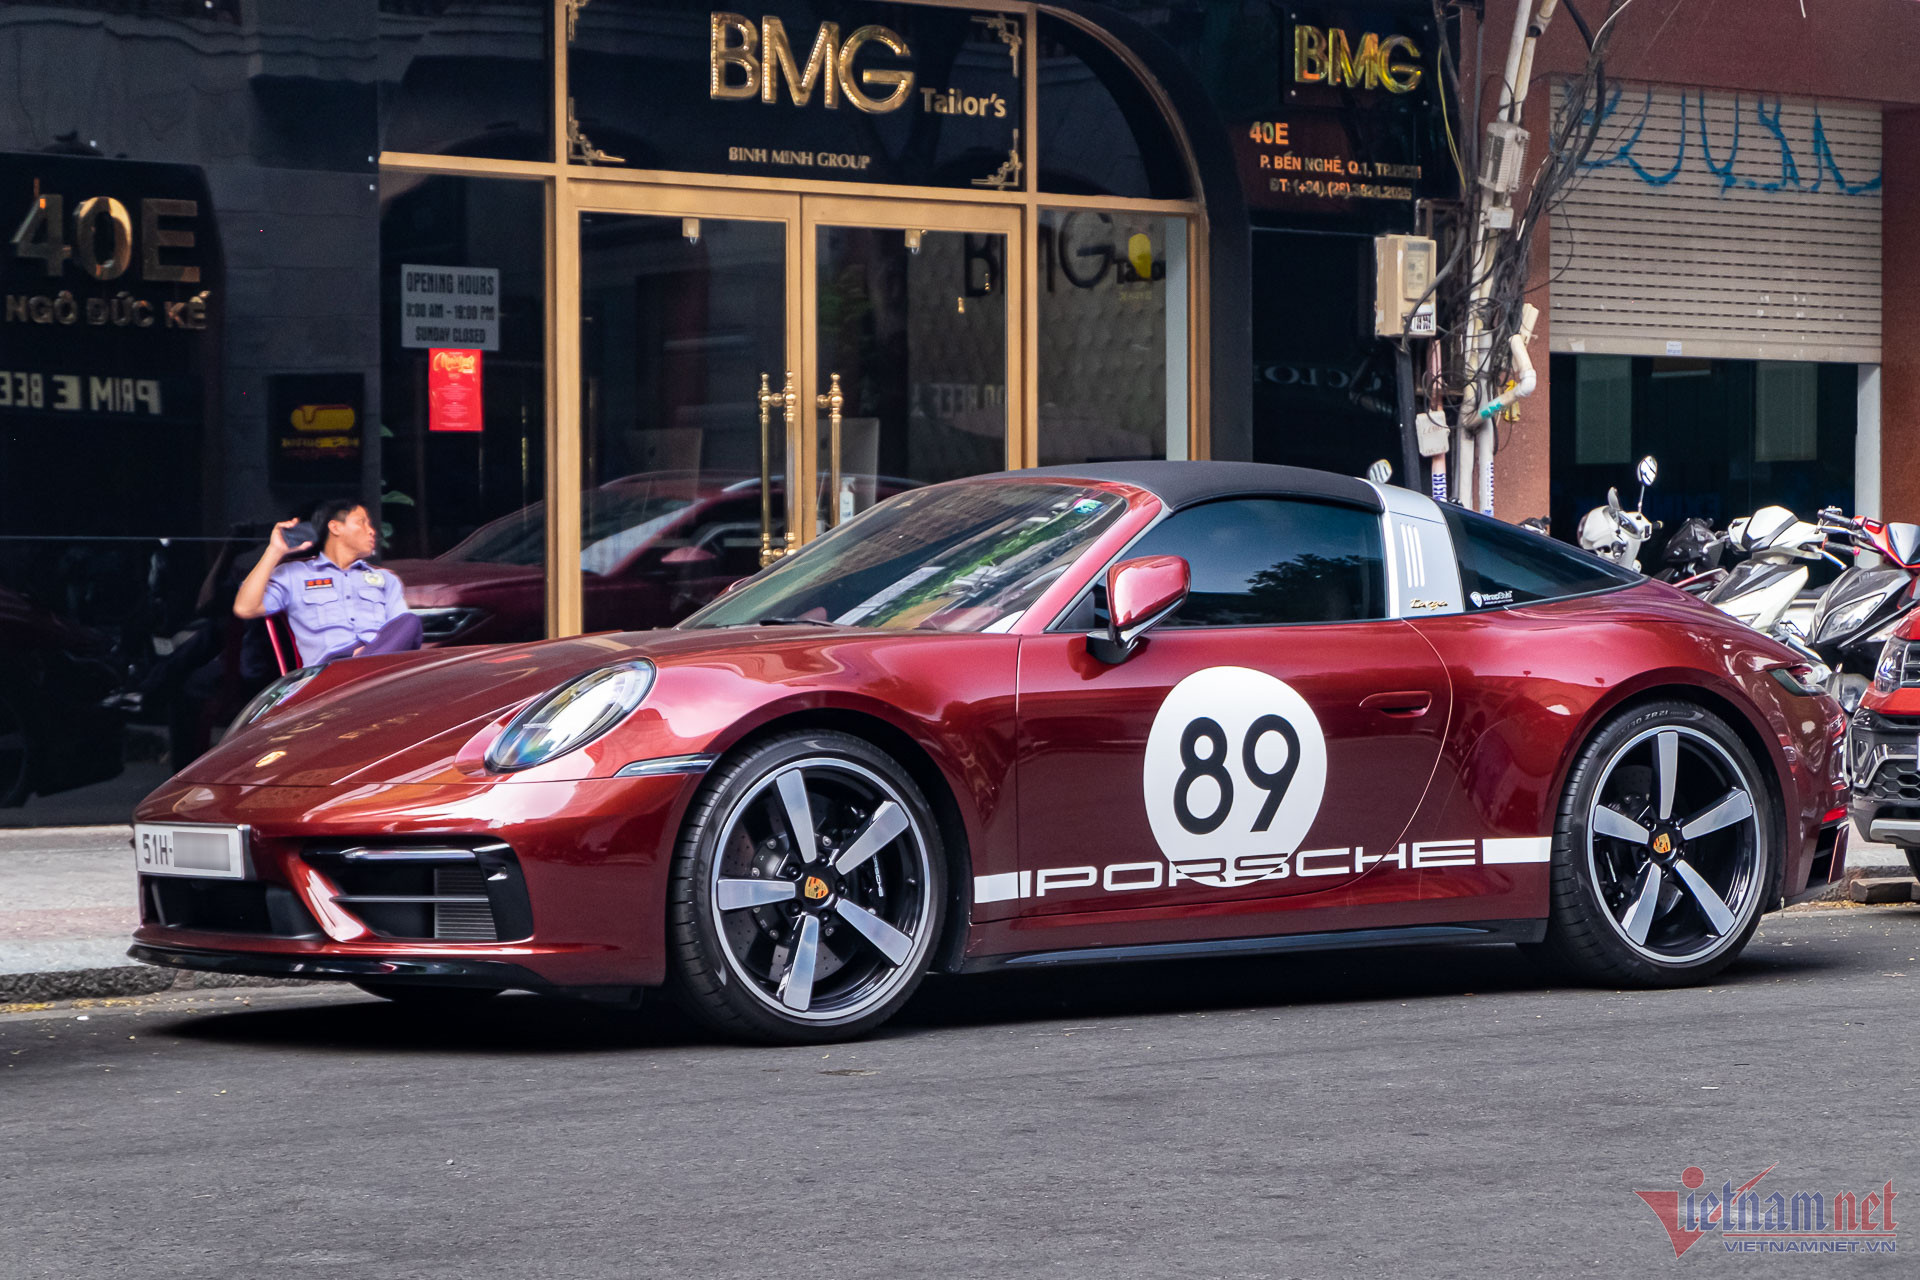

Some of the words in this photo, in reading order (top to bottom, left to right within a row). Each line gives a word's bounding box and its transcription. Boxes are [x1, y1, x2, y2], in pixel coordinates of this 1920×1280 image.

[711, 11, 914, 114] BMG
[920, 87, 1006, 118] Tailor's
[1295, 24, 1422, 93] BMG
[1250, 121, 1289, 145] 40E
[728, 146, 767, 163] BINH
[771, 149, 813, 166] MINH
[817, 152, 870, 169] GROUP
[1260, 154, 1271, 168] P.
[1348, 160, 1372, 177] Q.1,
[9, 194, 200, 282] 40E
[406, 271, 454, 294] OPENING
[457, 273, 494, 295] HOURS
[415, 326, 450, 342] SUNDAY
[452, 327, 486, 344] CLOSED
[1410, 597, 1448, 611] Targa
[1173, 714, 1300, 835] 89
[1036, 840, 1475, 897] PORSCHE
